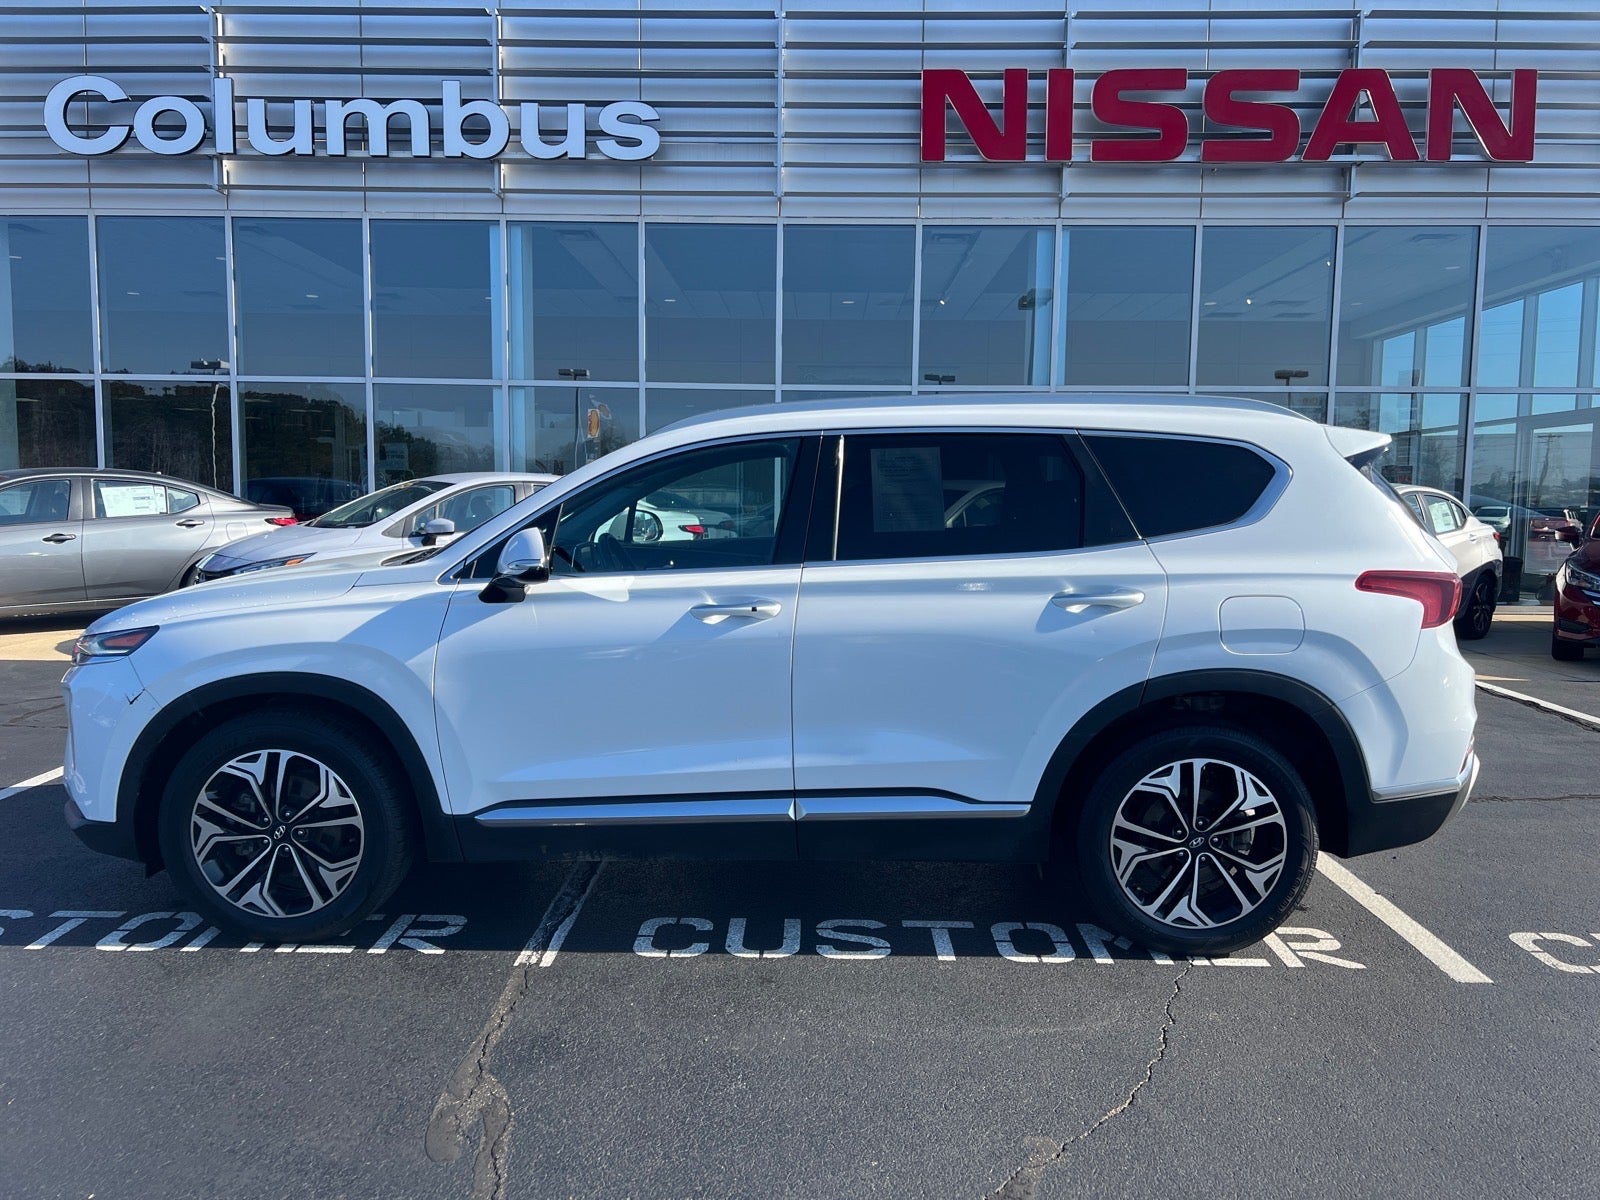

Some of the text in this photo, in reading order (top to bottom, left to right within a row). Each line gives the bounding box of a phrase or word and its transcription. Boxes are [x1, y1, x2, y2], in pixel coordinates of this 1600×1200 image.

[43, 68, 1538, 163] Columbus NISSAN
[1508, 932, 1600, 974] C
